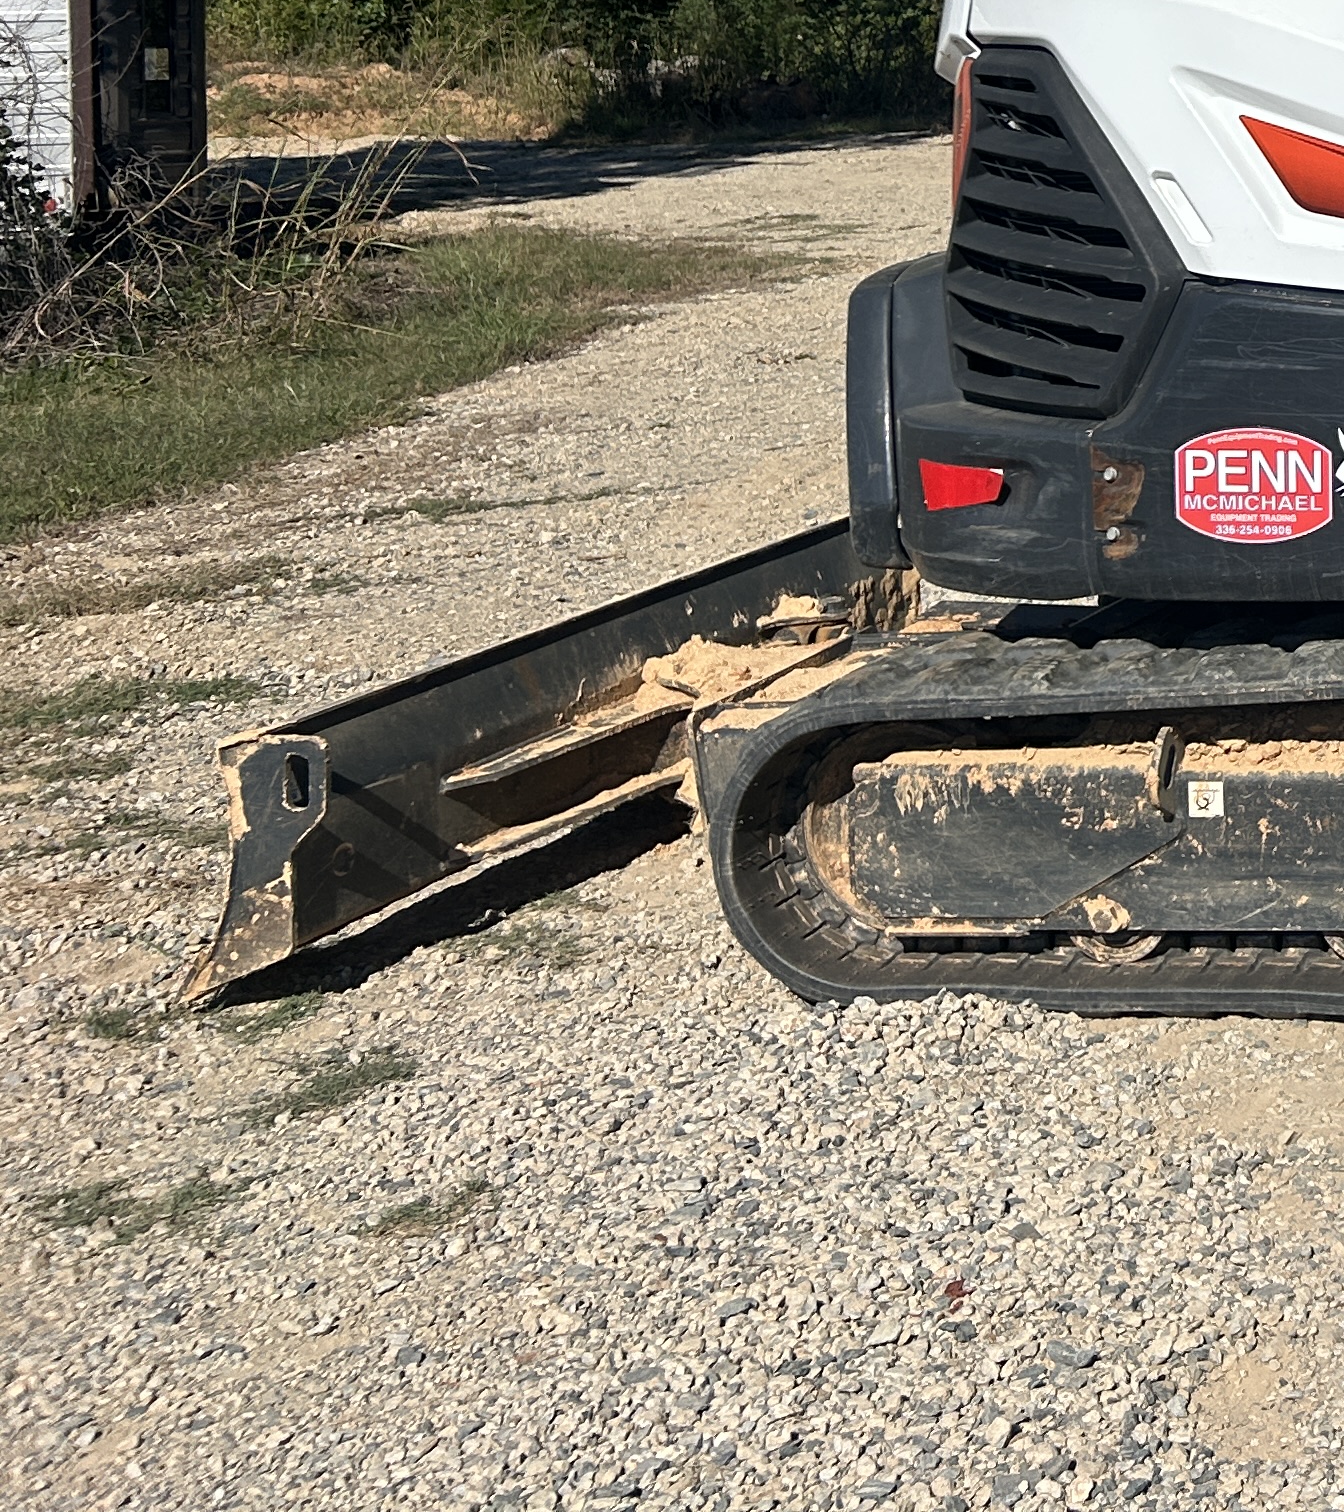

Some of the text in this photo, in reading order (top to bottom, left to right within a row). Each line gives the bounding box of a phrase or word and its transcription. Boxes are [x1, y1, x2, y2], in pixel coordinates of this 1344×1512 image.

[1184, 449, 1322, 493] PENN
[1184, 494, 1324, 511] MCMICHAEL
[1210, 513, 1297, 522] EQUIPMENT TRADING
